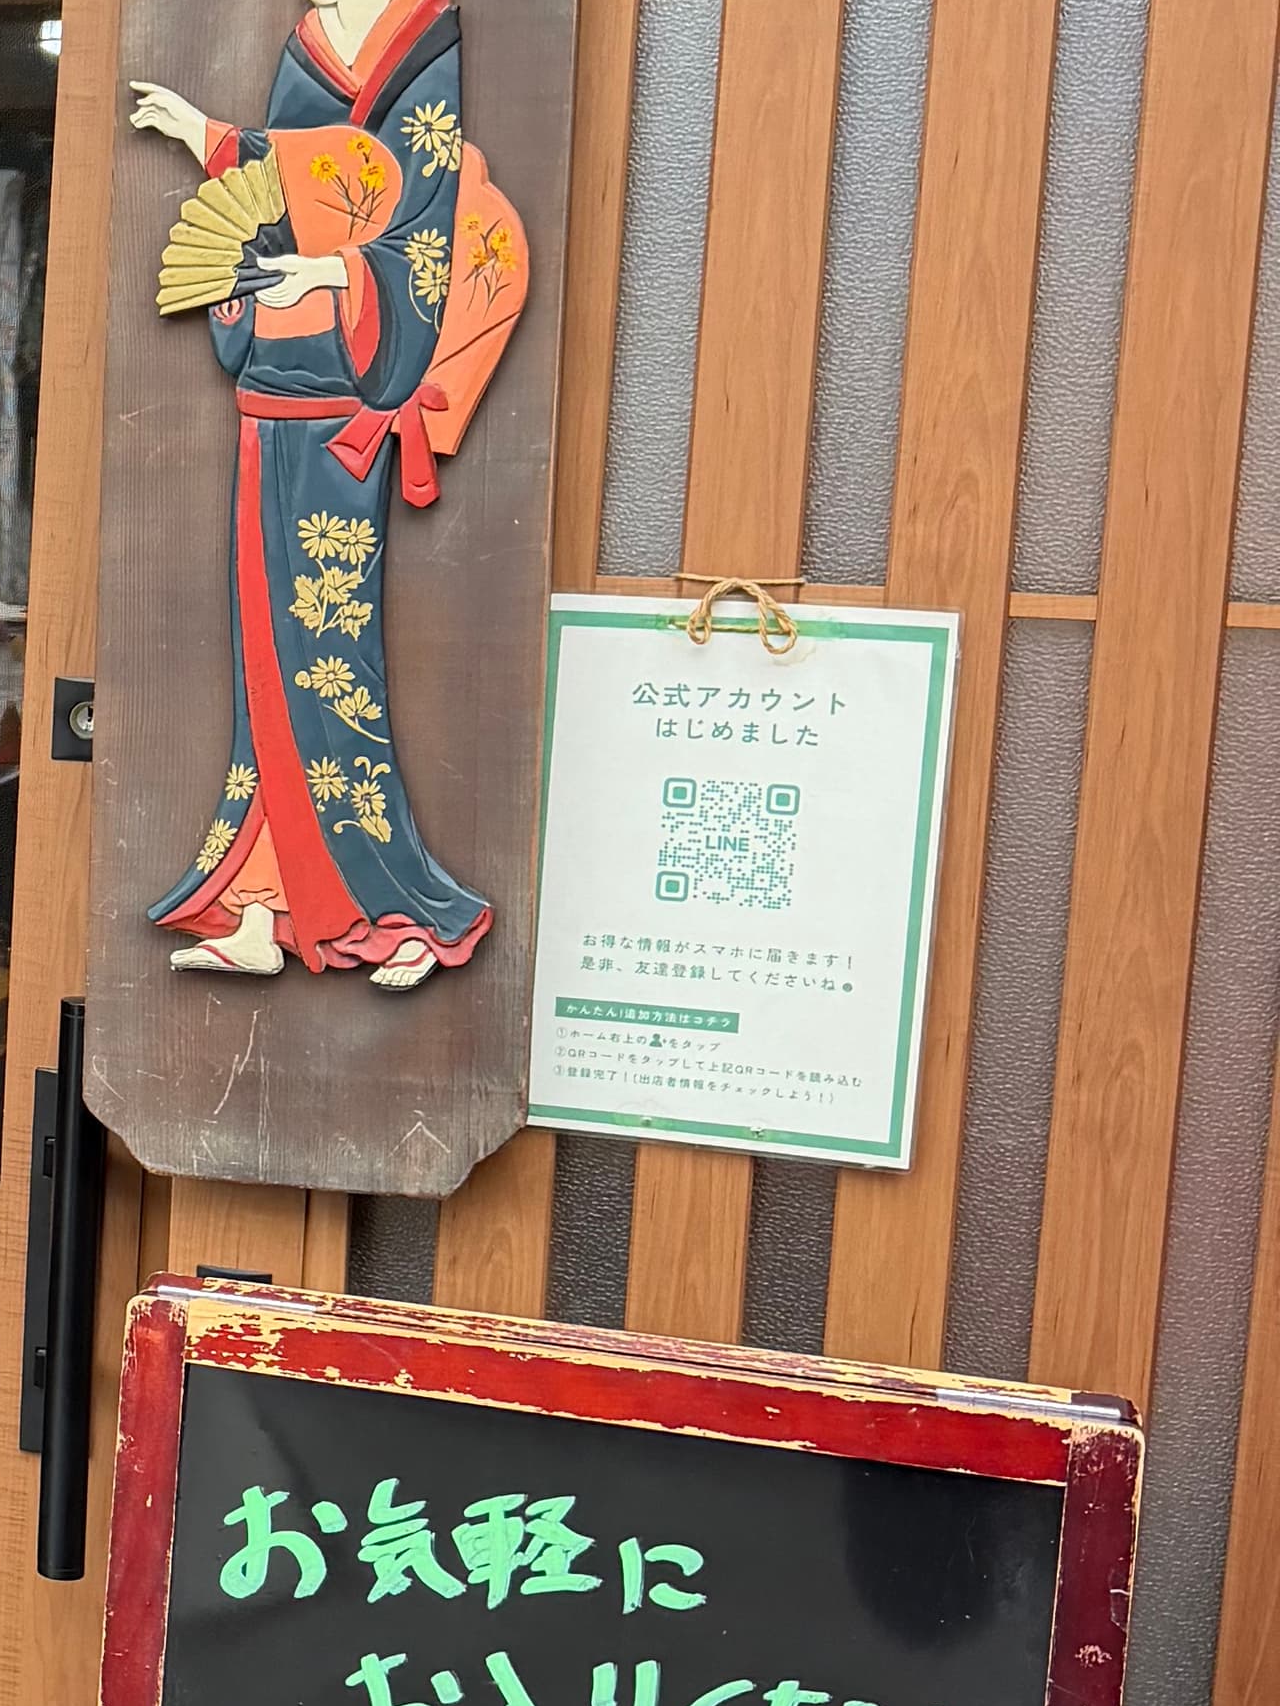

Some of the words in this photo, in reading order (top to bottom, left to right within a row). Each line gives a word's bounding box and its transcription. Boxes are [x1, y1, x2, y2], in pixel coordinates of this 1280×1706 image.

[632, 681, 847, 716] 公式アカウント
[655, 718, 820, 747] はじめました
[705, 834, 750, 853] LINE
[582, 934, 853, 970] お得な情報がスマホに届きます！
[219, 1477, 708, 1613] お気軽に
